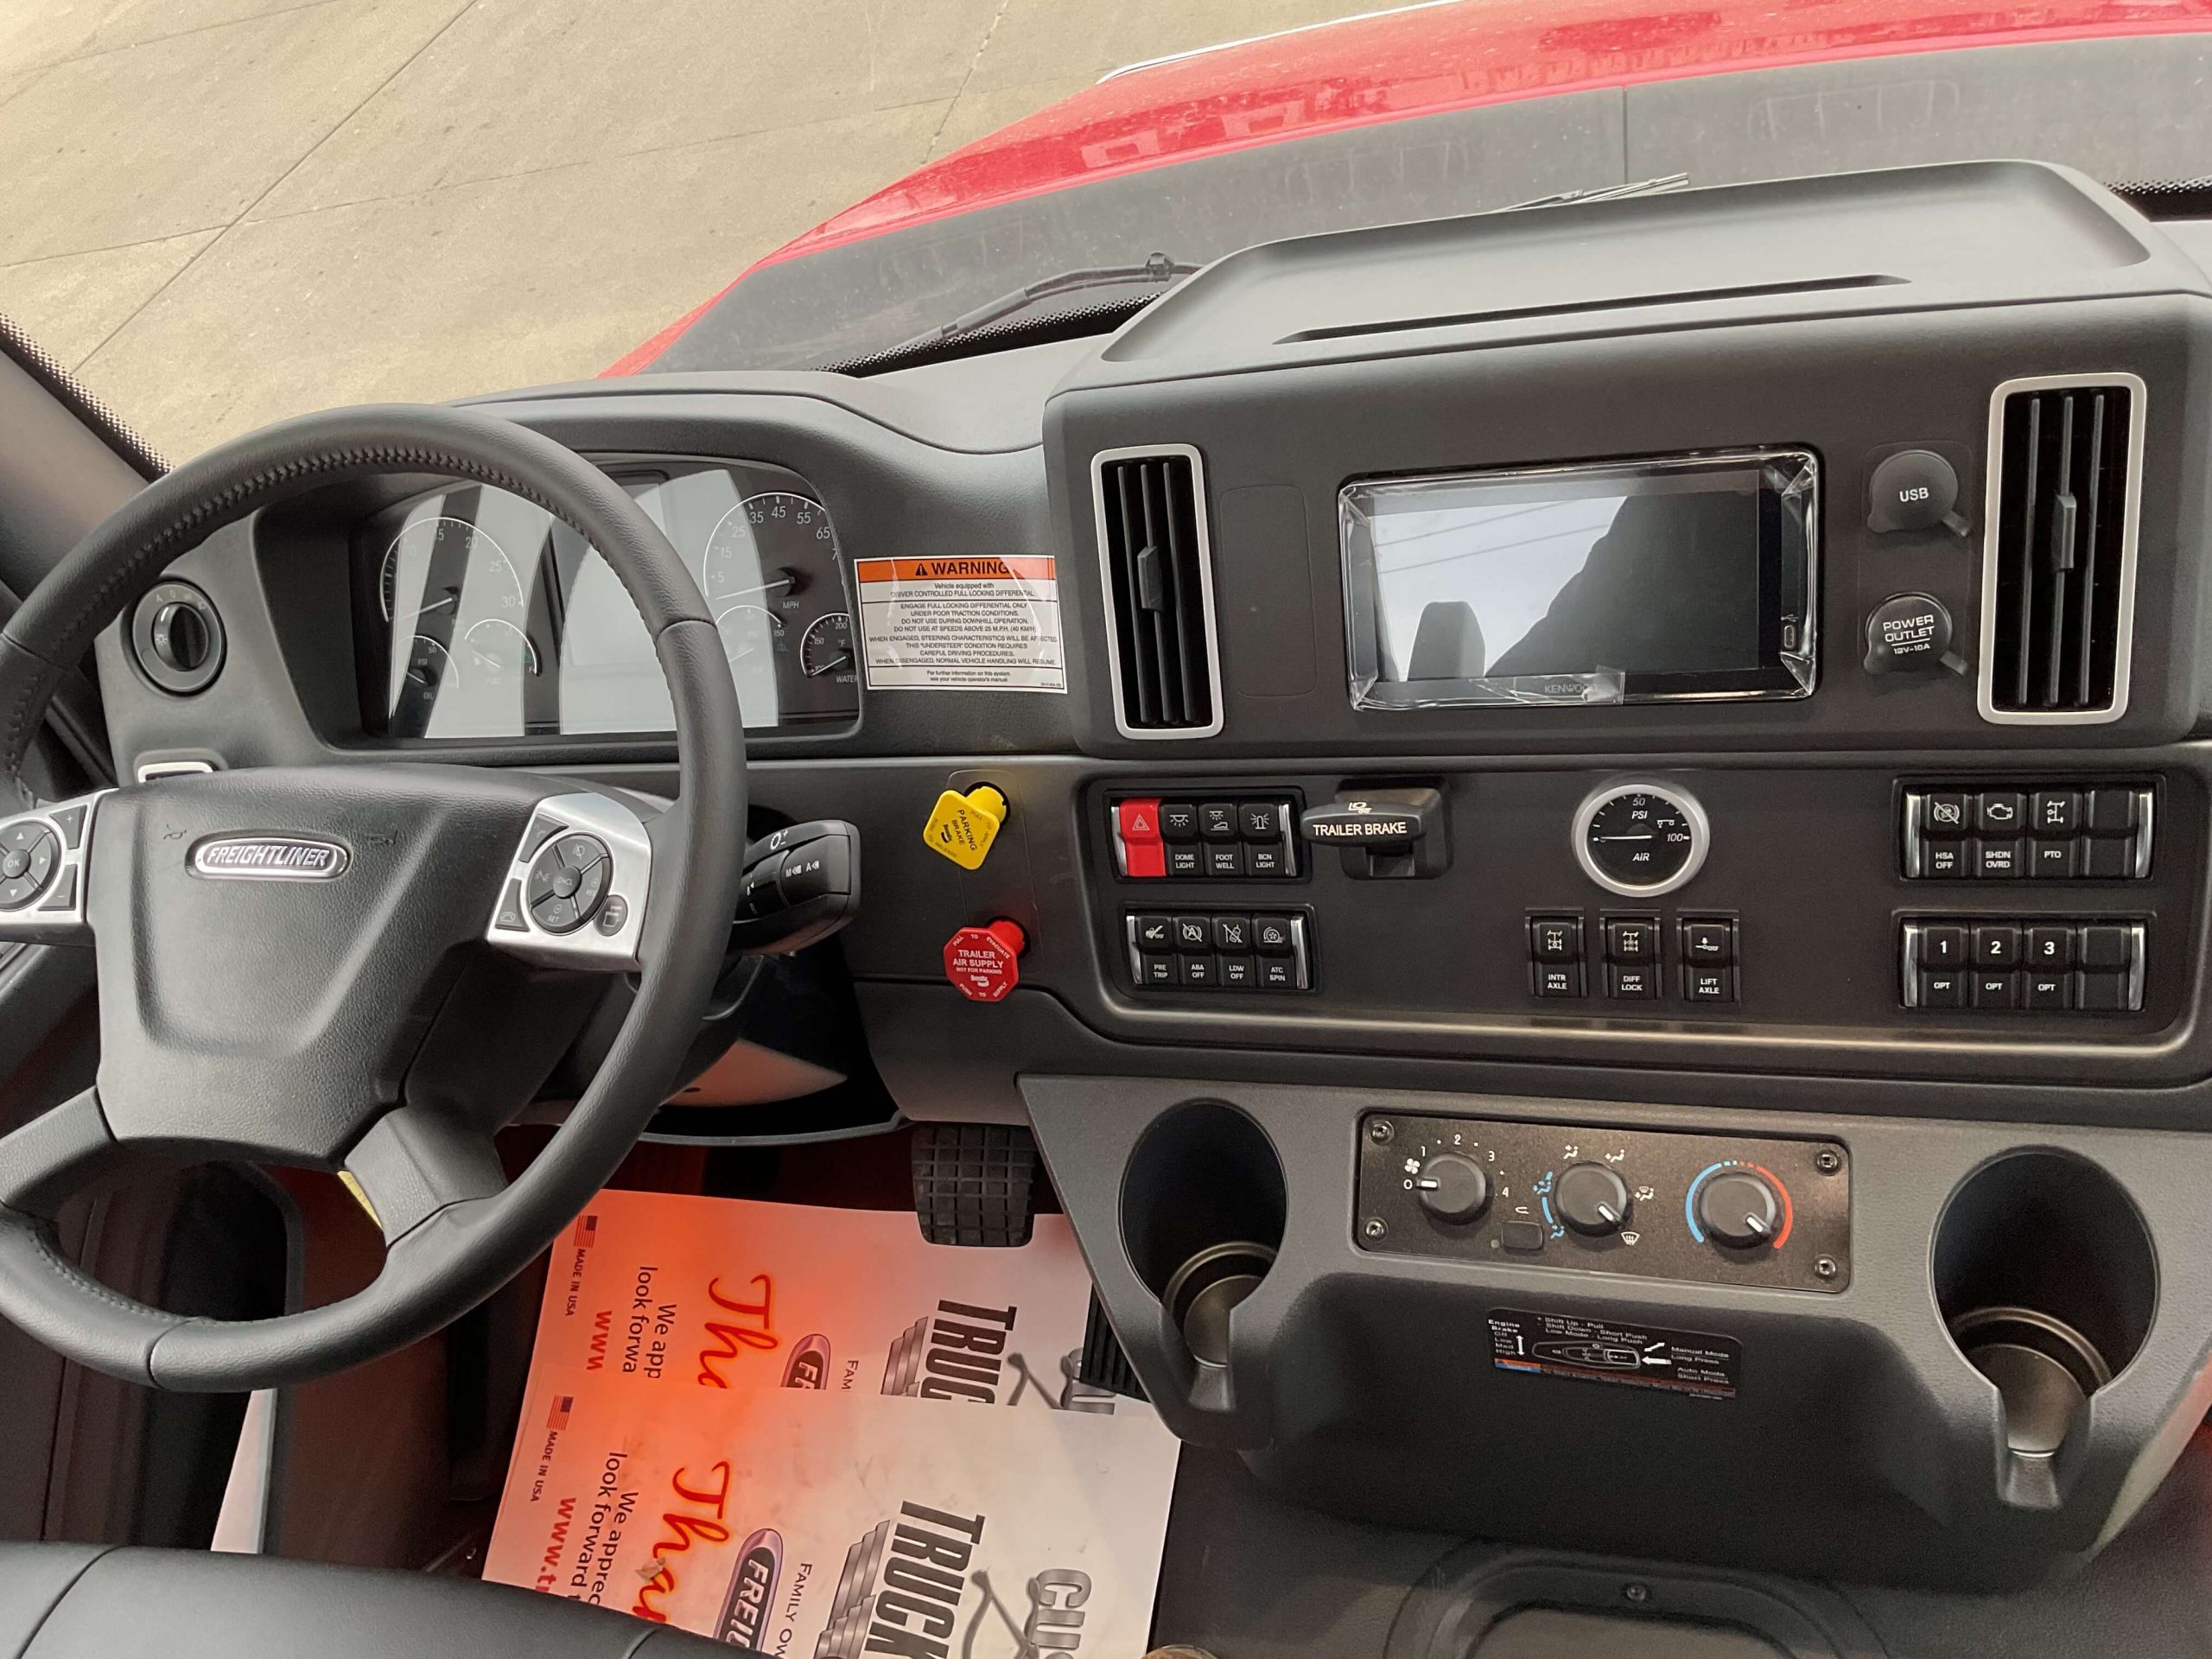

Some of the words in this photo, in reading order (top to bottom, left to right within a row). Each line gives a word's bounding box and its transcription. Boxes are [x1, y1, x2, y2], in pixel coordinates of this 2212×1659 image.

[1899, 487, 1929, 502] USB
[750, 511, 764, 524] 35
[772, 505, 786, 518] 45
[797, 512, 811, 524] 55
[732, 526, 746, 537] 25
[816, 527, 830, 539] 65
[465, 537, 478, 549] 20
[931, 562, 1010, 575] WARNING
[502, 595, 516, 607] 30
[1883, 614, 1934, 632] POWER
[1885, 626, 1935, 642] OUTLET
[1632, 798, 1646, 807] 50
[1631, 810, 1648, 820] PSI
[951, 820, 965, 845] BRAKE
[957, 809, 977, 851] PARKING
[1313, 823, 1362, 837] TRAILER
[1364, 822, 1407, 836] BRAKE
[1666, 833, 1684, 842] 100
[207, 845, 330, 867] FREIGHTLINER
[1633, 852, 1650, 862] AIR
[1935, 851, 1954, 860] HSA
[1985, 851, 2011, 859] SHDN
[7, 859, 20, 868] OK
[1255, 861, 1275, 869] LIGHT
[1936, 861, 1953, 869] OFF
[1986, 860, 2011, 869] OVRD
[986, 936, 1011, 959] EVACUATE
[1940, 941, 1947, 953] 1
[1990, 941, 2002, 955] 2
[2044, 941, 2055, 955] 3
[958, 949, 995, 959] TRAILER
[969, 959, 1003, 969] SUPPLY
[1621, 983, 1642, 991] LOCK
[1698, 986, 1719, 994] AXLE
[2038, 983, 2056, 992] OPT
[1454, 1134, 1461, 1145] 2
[1421, 1146, 1426, 1157] 1
[1488, 1150, 1495, 1162] 3
[1403, 1179, 1413, 1190] 0
[1502, 1187, 1509, 1197] 4
[572, 1248, 586, 1278] MADE
[570, 1281, 580, 1292] IN
[632, 1266, 658, 1310] look
[565, 1296, 577, 1316] USA
[654, 1305, 677, 1335] We
[1488, 1319, 1520, 1328] Engine
[1492, 1325, 1518, 1333] Brake
[622, 1315, 650, 1373] forwa
[1597, 1334, 1618, 1342] Long
[1671, 1346, 1703, 1355] Manual
[644, 1341, 666, 1379] app
[1703, 1376, 1729, 1384] Press
[542, 1431, 558, 1461] MADE
[537, 1465, 549, 1477] IN
[597, 1452, 628, 1498] look
[530, 1480, 544, 1502] USA
[613, 1492, 639, 1524] We
[570, 1503, 612, 1587] forward
[588, 1529, 621, 1605] apprec
[864, 1500, 986, 1659] TRUCK
[785, 1562, 813, 1623] FAMILY
